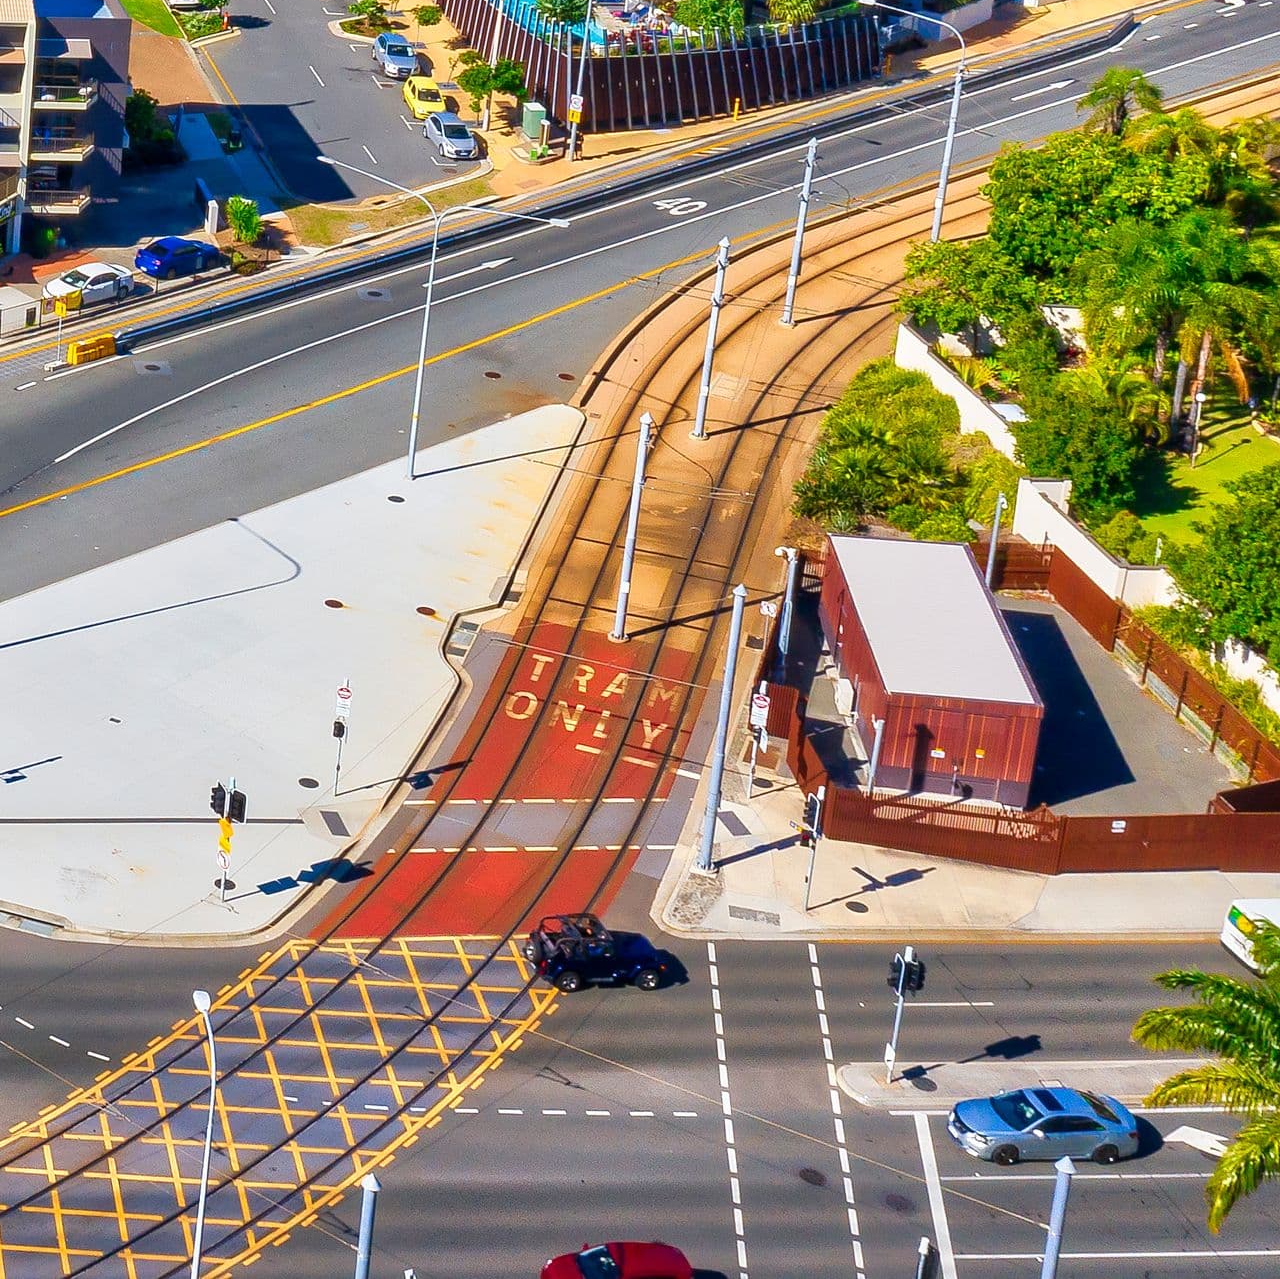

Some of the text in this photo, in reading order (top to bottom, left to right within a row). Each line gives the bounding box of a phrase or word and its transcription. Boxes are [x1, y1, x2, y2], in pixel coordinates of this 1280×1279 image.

[652, 197, 708, 216] 40
[530, 654, 685, 712] TRAM
[505, 692, 668, 749] ONLY
